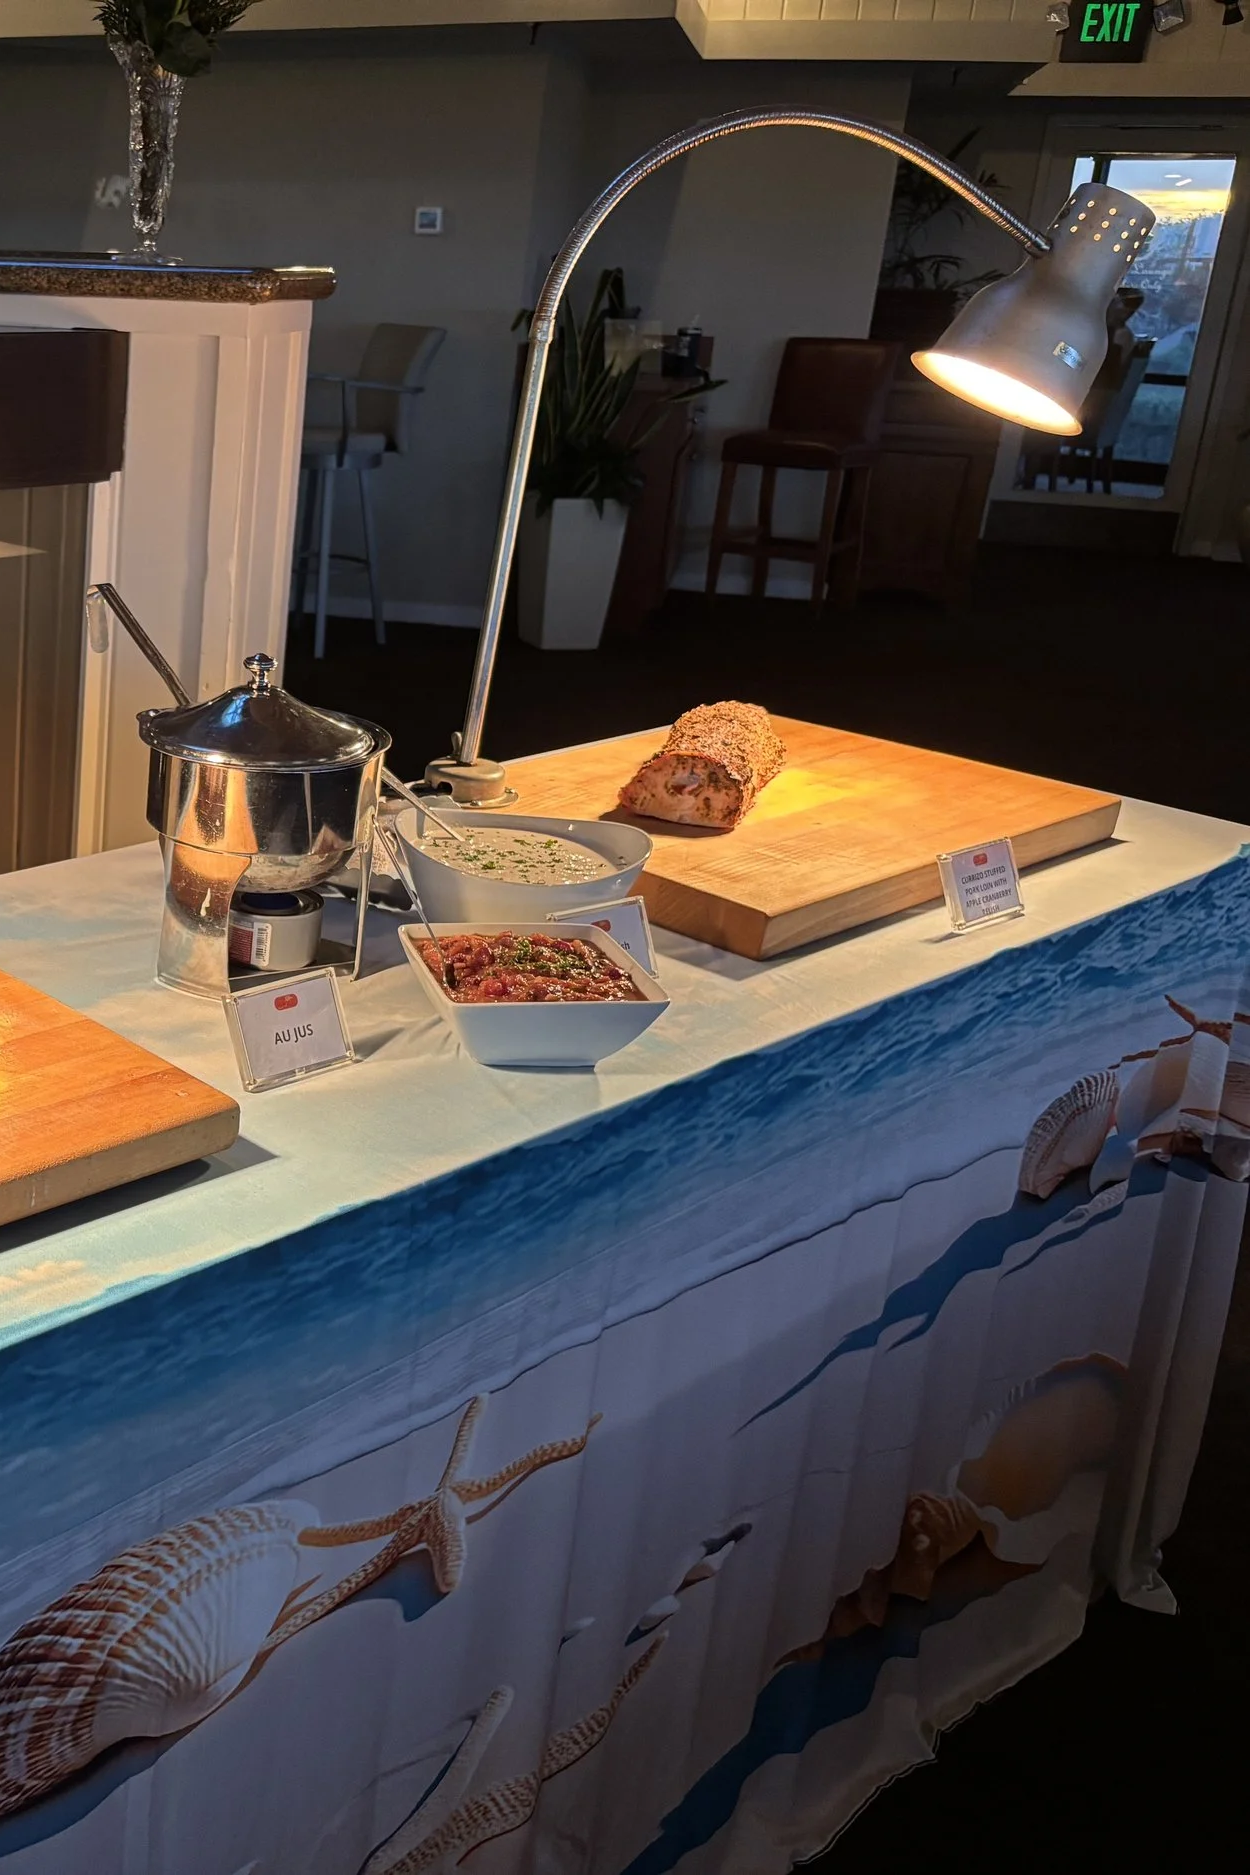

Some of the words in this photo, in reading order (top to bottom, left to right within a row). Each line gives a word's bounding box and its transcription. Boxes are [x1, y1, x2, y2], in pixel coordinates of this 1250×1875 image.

[1080, 3, 1141, 42] EXIT
[984, 865, 1006, 878] STUFFED
[965, 885, 981, 897] PORK
[980, 880, 993, 892] LOIN
[994, 877, 1008, 888] WITH
[966, 897, 982, 908] APPLE
[982, 888, 1012, 903] CRANBERRY
[275, 1029, 291, 1045] AU
[293, 1023, 314, 1043] JUS
